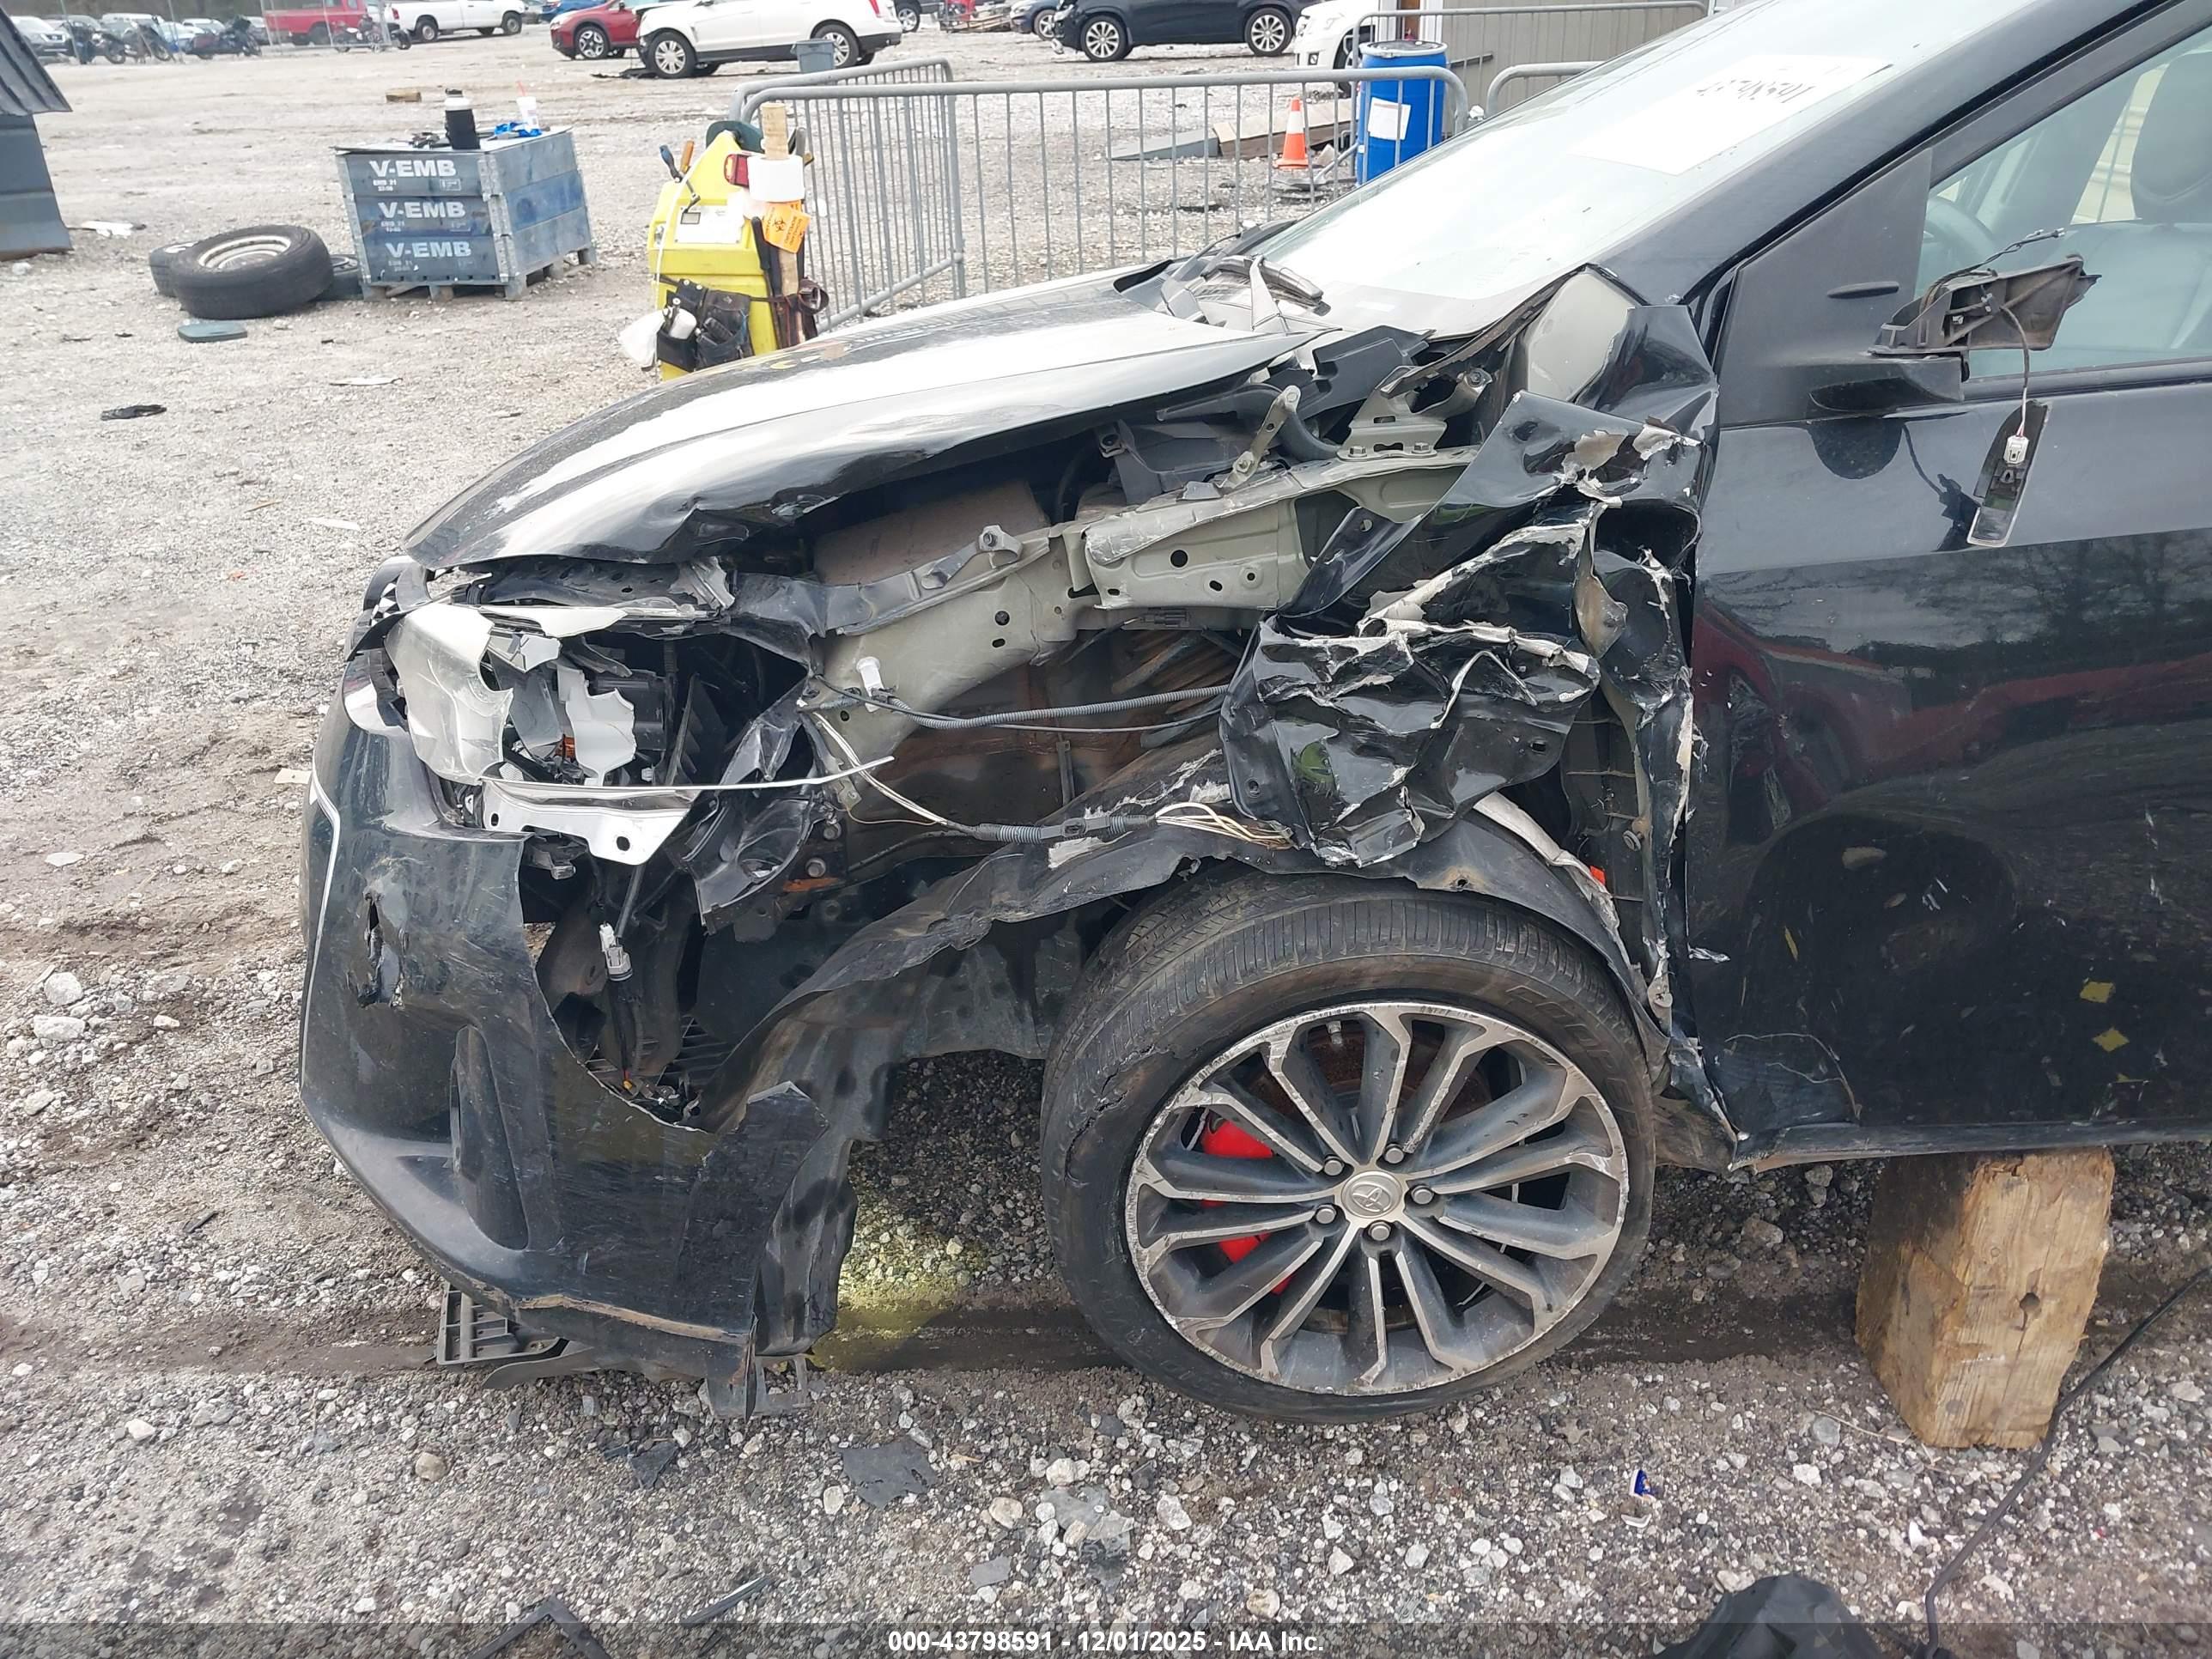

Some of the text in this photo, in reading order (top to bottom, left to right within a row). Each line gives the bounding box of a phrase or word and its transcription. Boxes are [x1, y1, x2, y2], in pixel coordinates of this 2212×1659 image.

[368, 160, 457, 178] V-EMB
[378, 201, 466, 218] V-EMB
[385, 240, 472, 258] V-EMB
